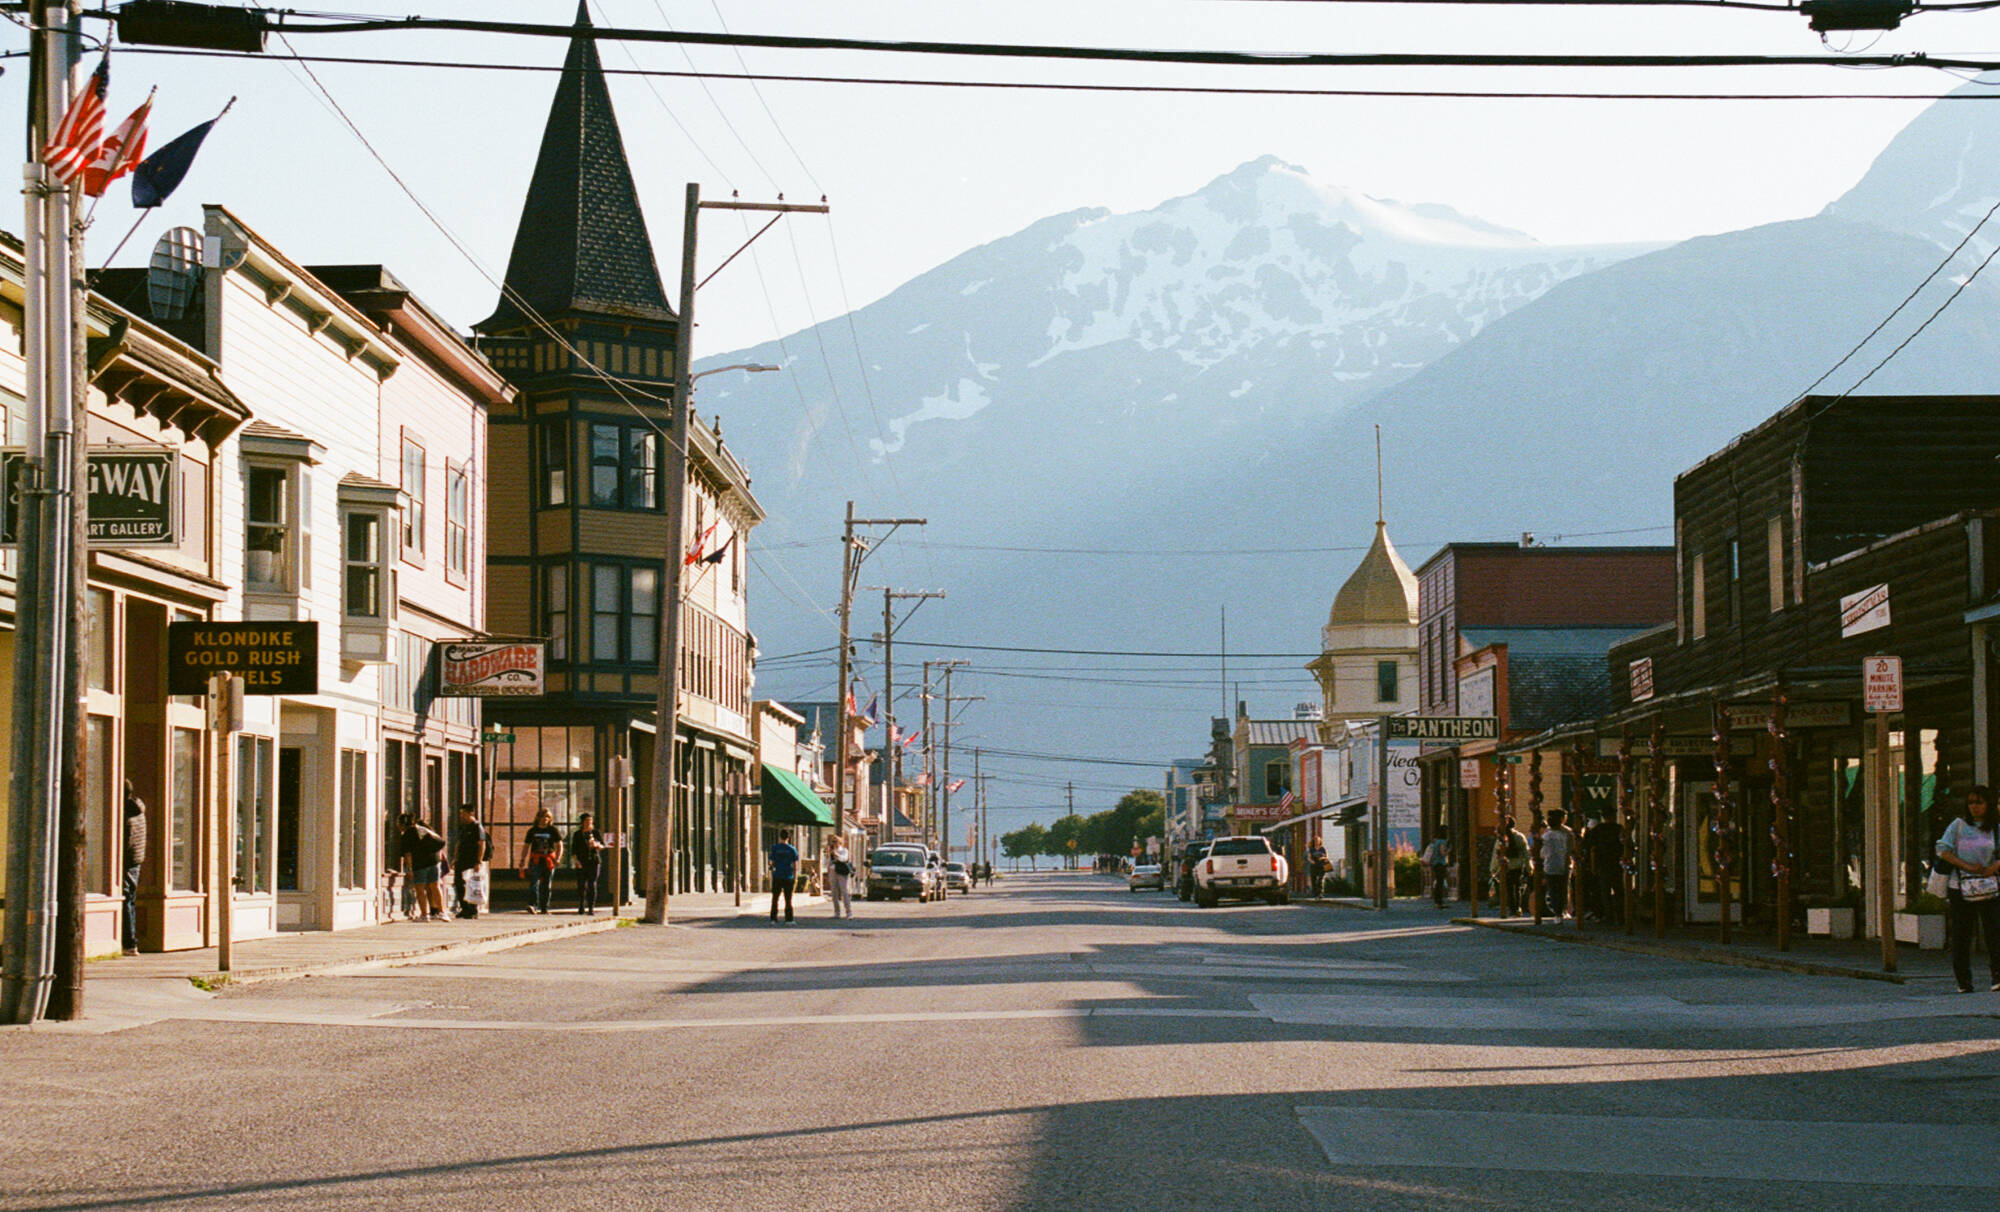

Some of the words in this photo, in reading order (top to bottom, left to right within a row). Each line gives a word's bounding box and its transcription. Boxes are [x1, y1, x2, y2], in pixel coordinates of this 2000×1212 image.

[110, 523, 162, 535] GALLERY
[194, 631, 293, 646] KLONDIKE
[185, 651, 238, 665] GOLD
[249, 651, 301, 665] RUSH
[445, 646, 537, 685] HARDWARE
[1876, 662, 1888, 672] 20
[204, 670, 283, 685] JELS
[1870, 674, 1894, 682] MINUTE
[1868, 684, 1896, 692] PARKING
[1407, 719, 1494, 737] PANTHEON
